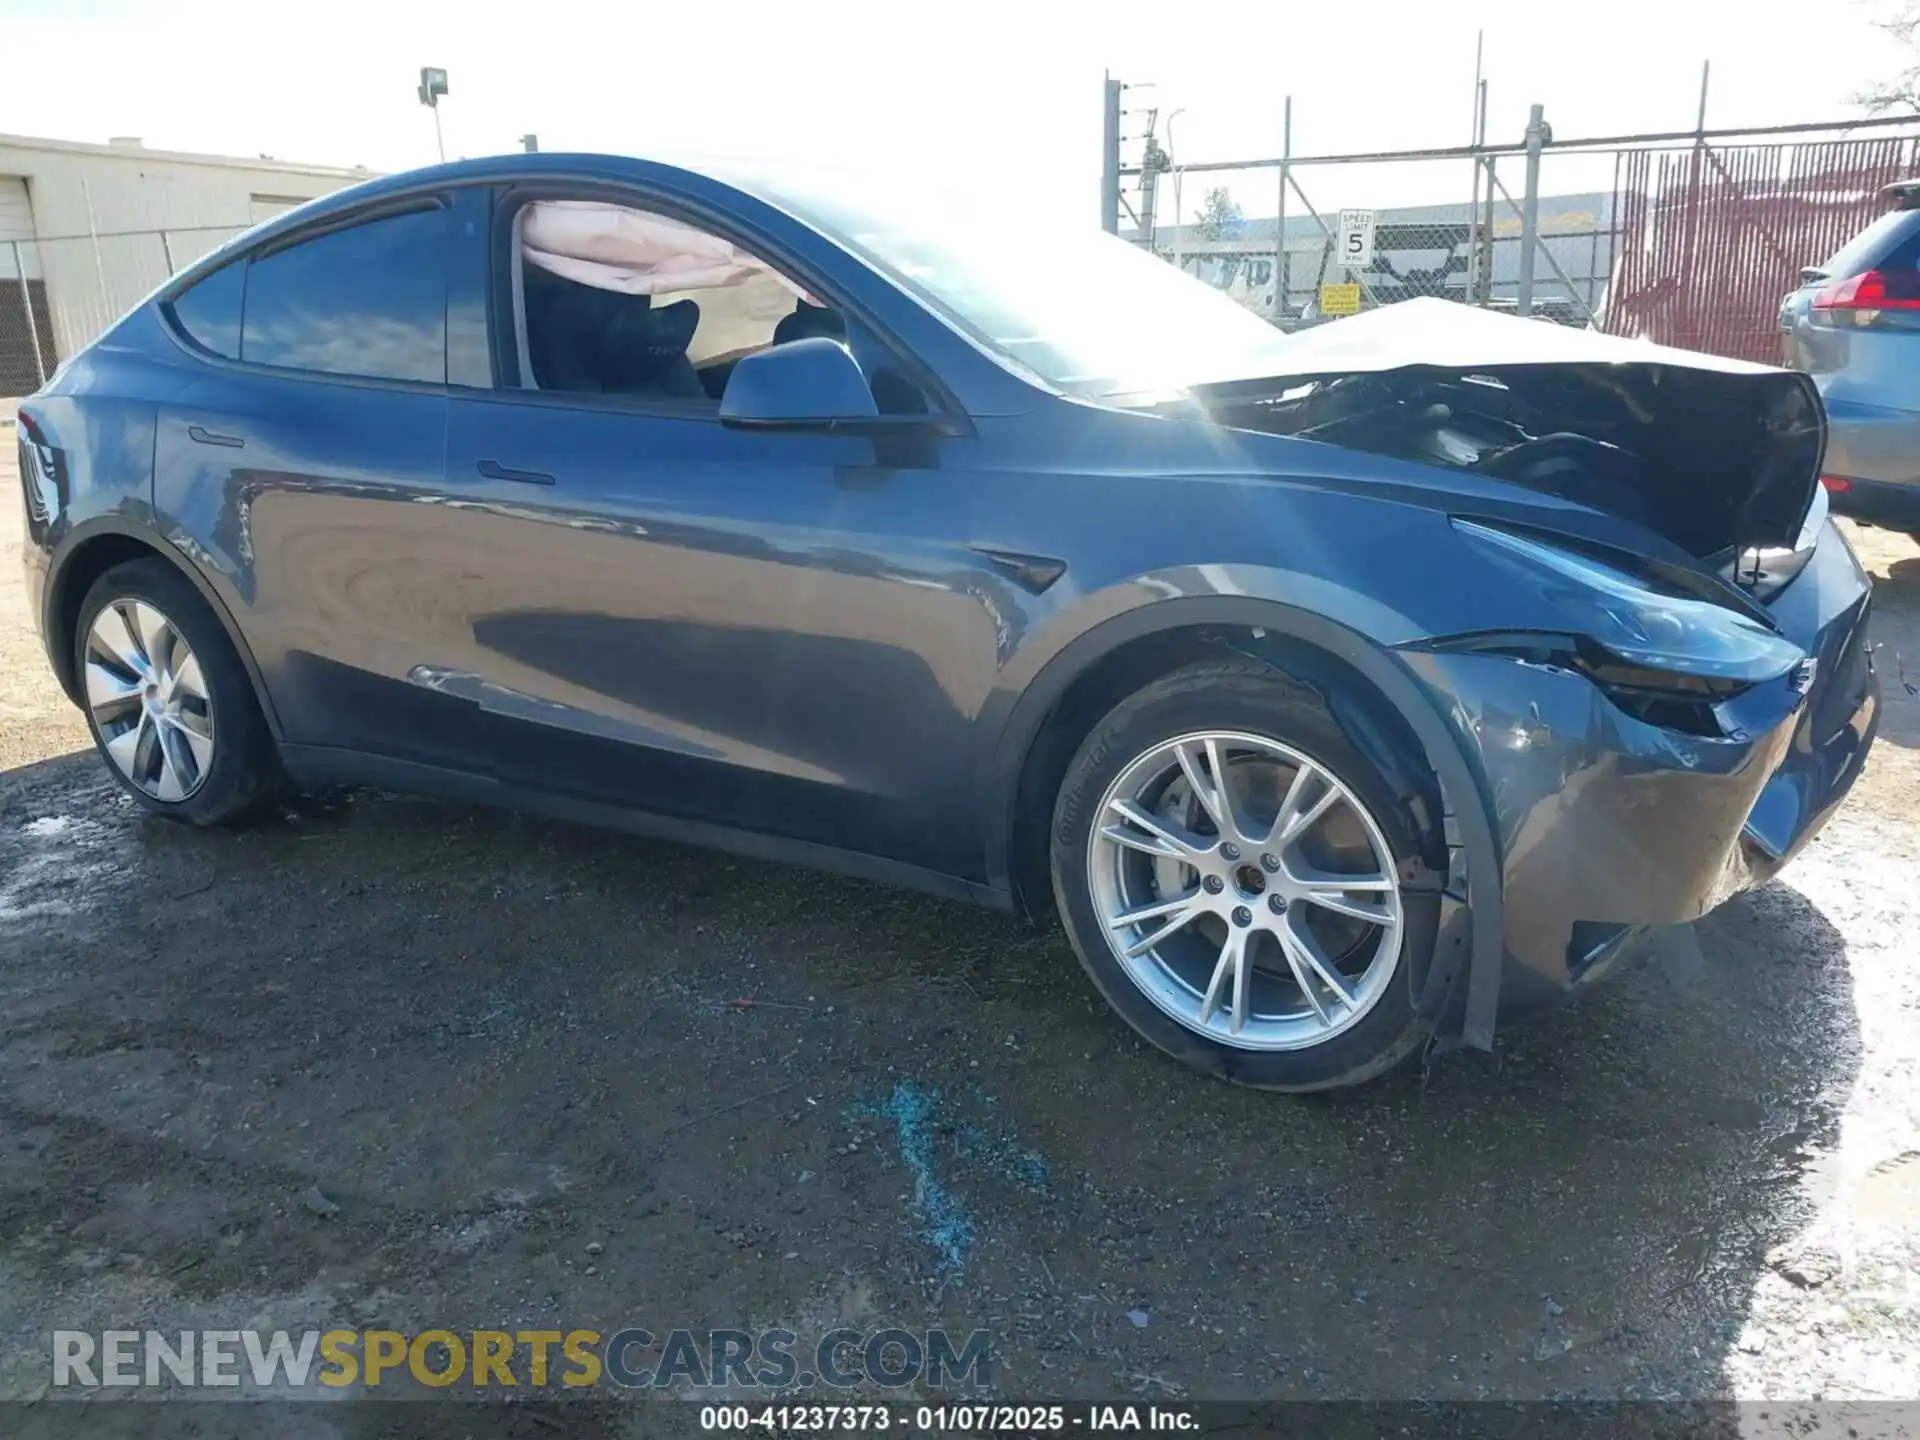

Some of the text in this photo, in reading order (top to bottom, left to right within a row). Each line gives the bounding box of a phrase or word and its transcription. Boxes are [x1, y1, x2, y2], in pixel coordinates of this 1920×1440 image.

[1343, 214, 1370, 223] SPEED
[1345, 223, 1368, 231] LIMIT
[1348, 233, 1363, 253] 5
